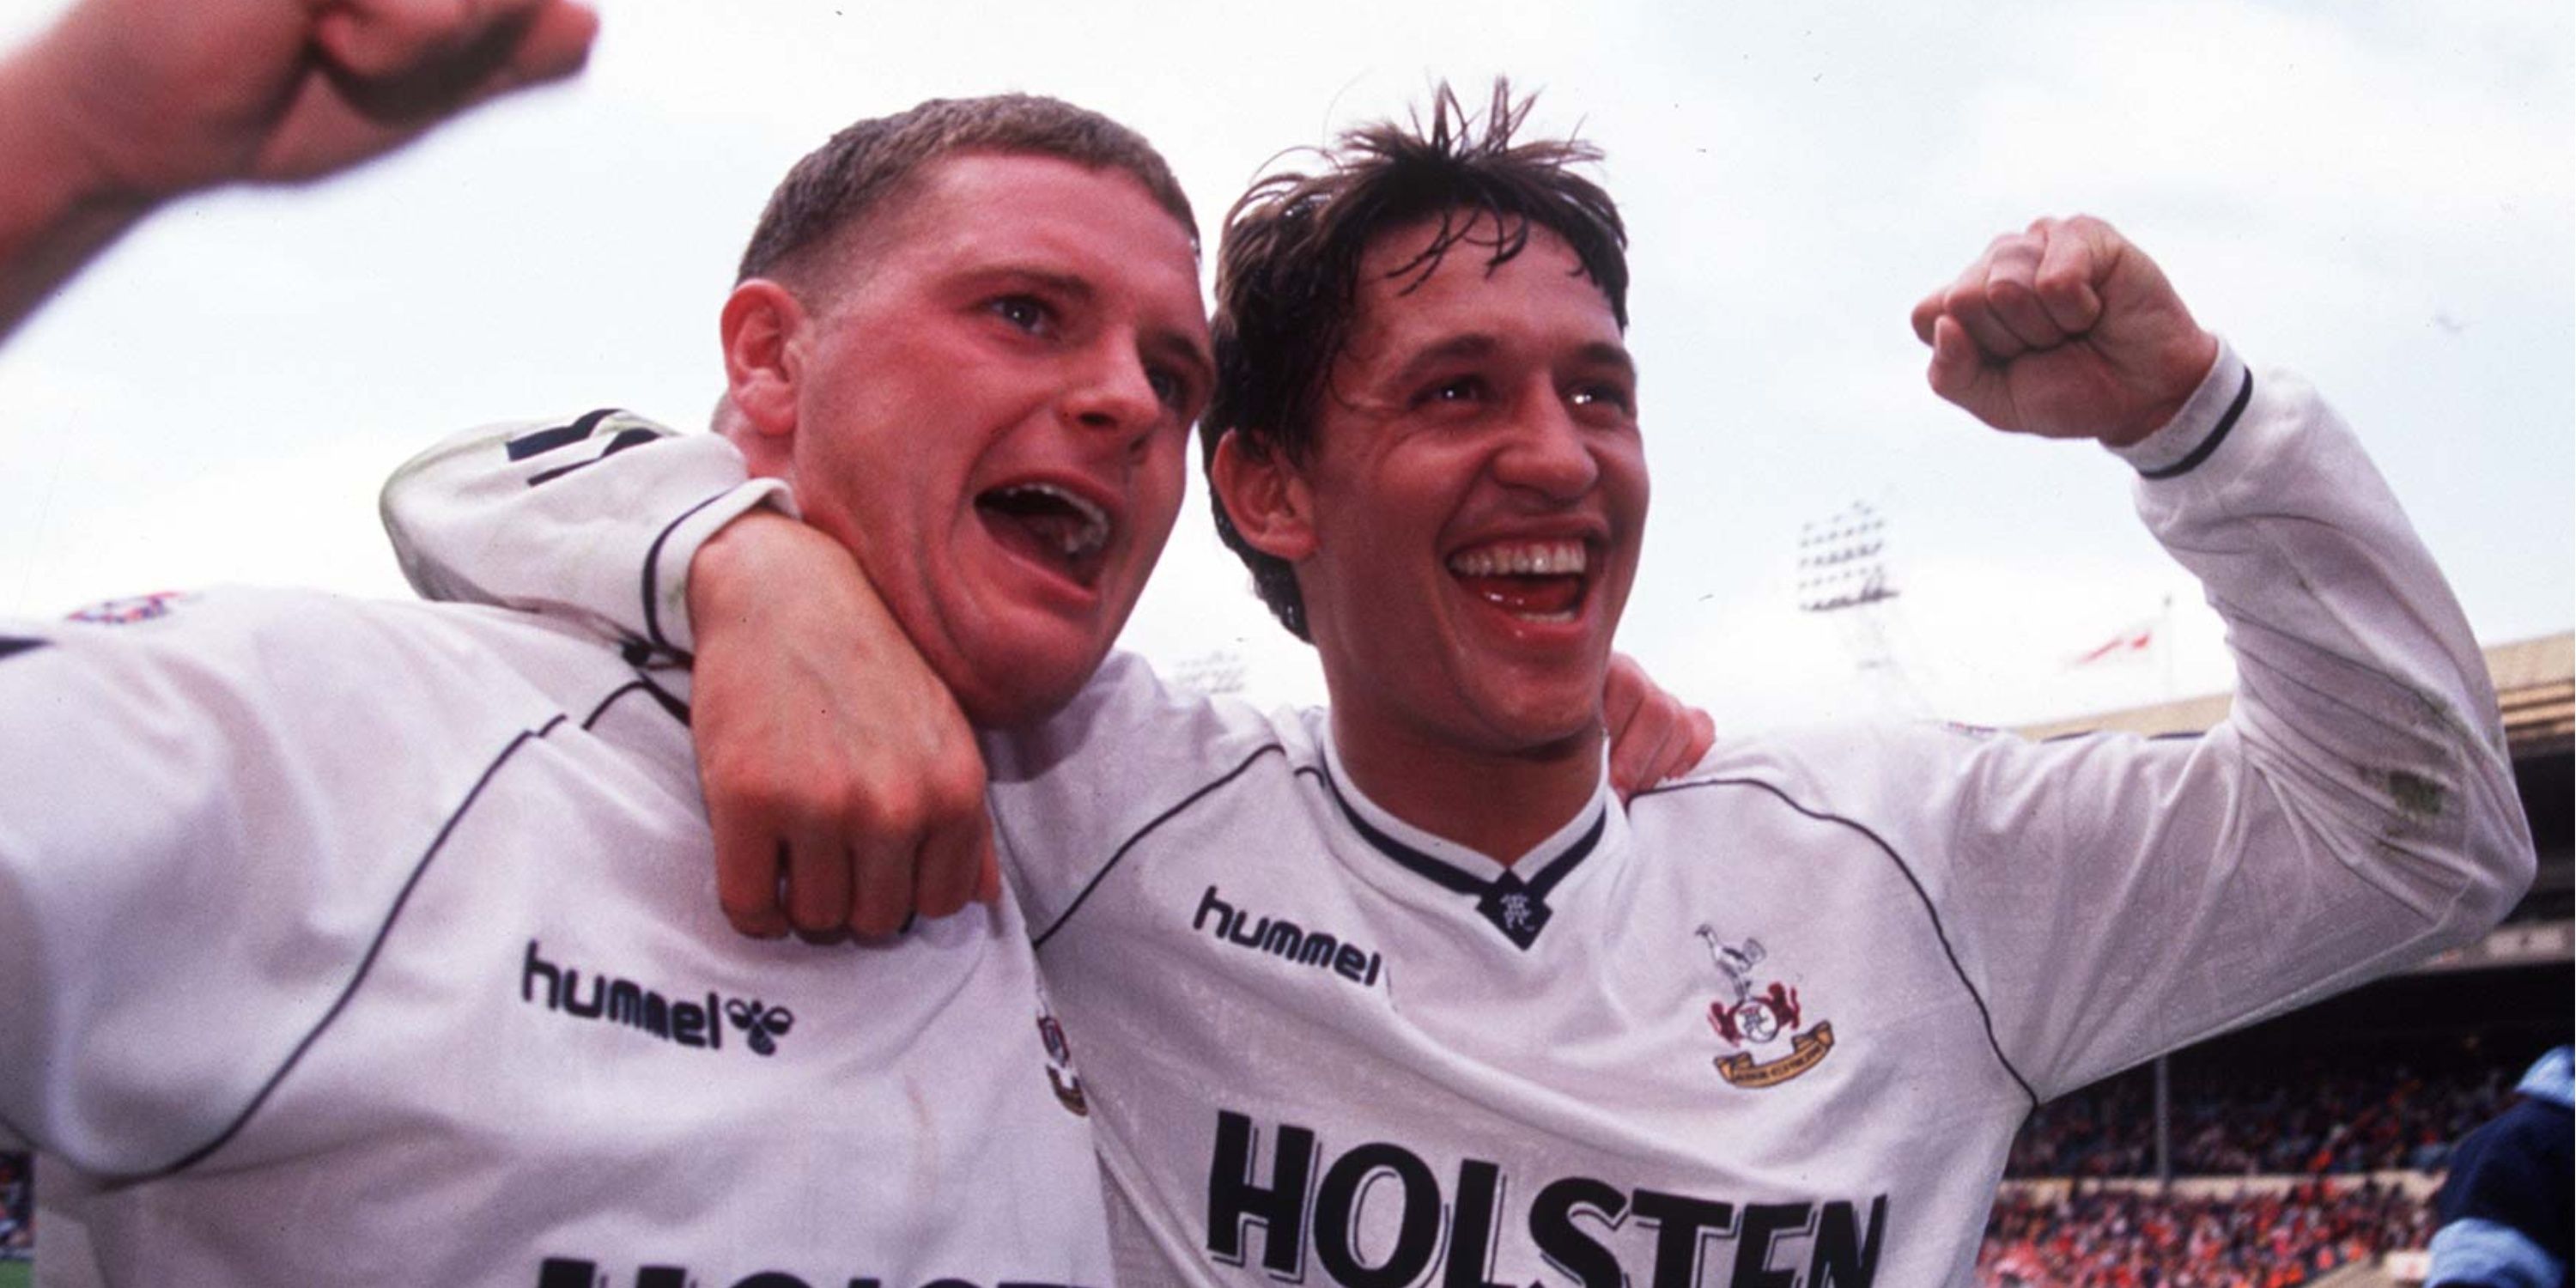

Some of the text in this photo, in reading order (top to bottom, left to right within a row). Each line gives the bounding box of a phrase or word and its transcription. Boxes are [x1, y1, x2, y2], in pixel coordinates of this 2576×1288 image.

[1193, 885, 1381, 987] hummel
[522, 939, 720, 1049] hummel
[1207, 1109, 1888, 1288] HOLSTEN
